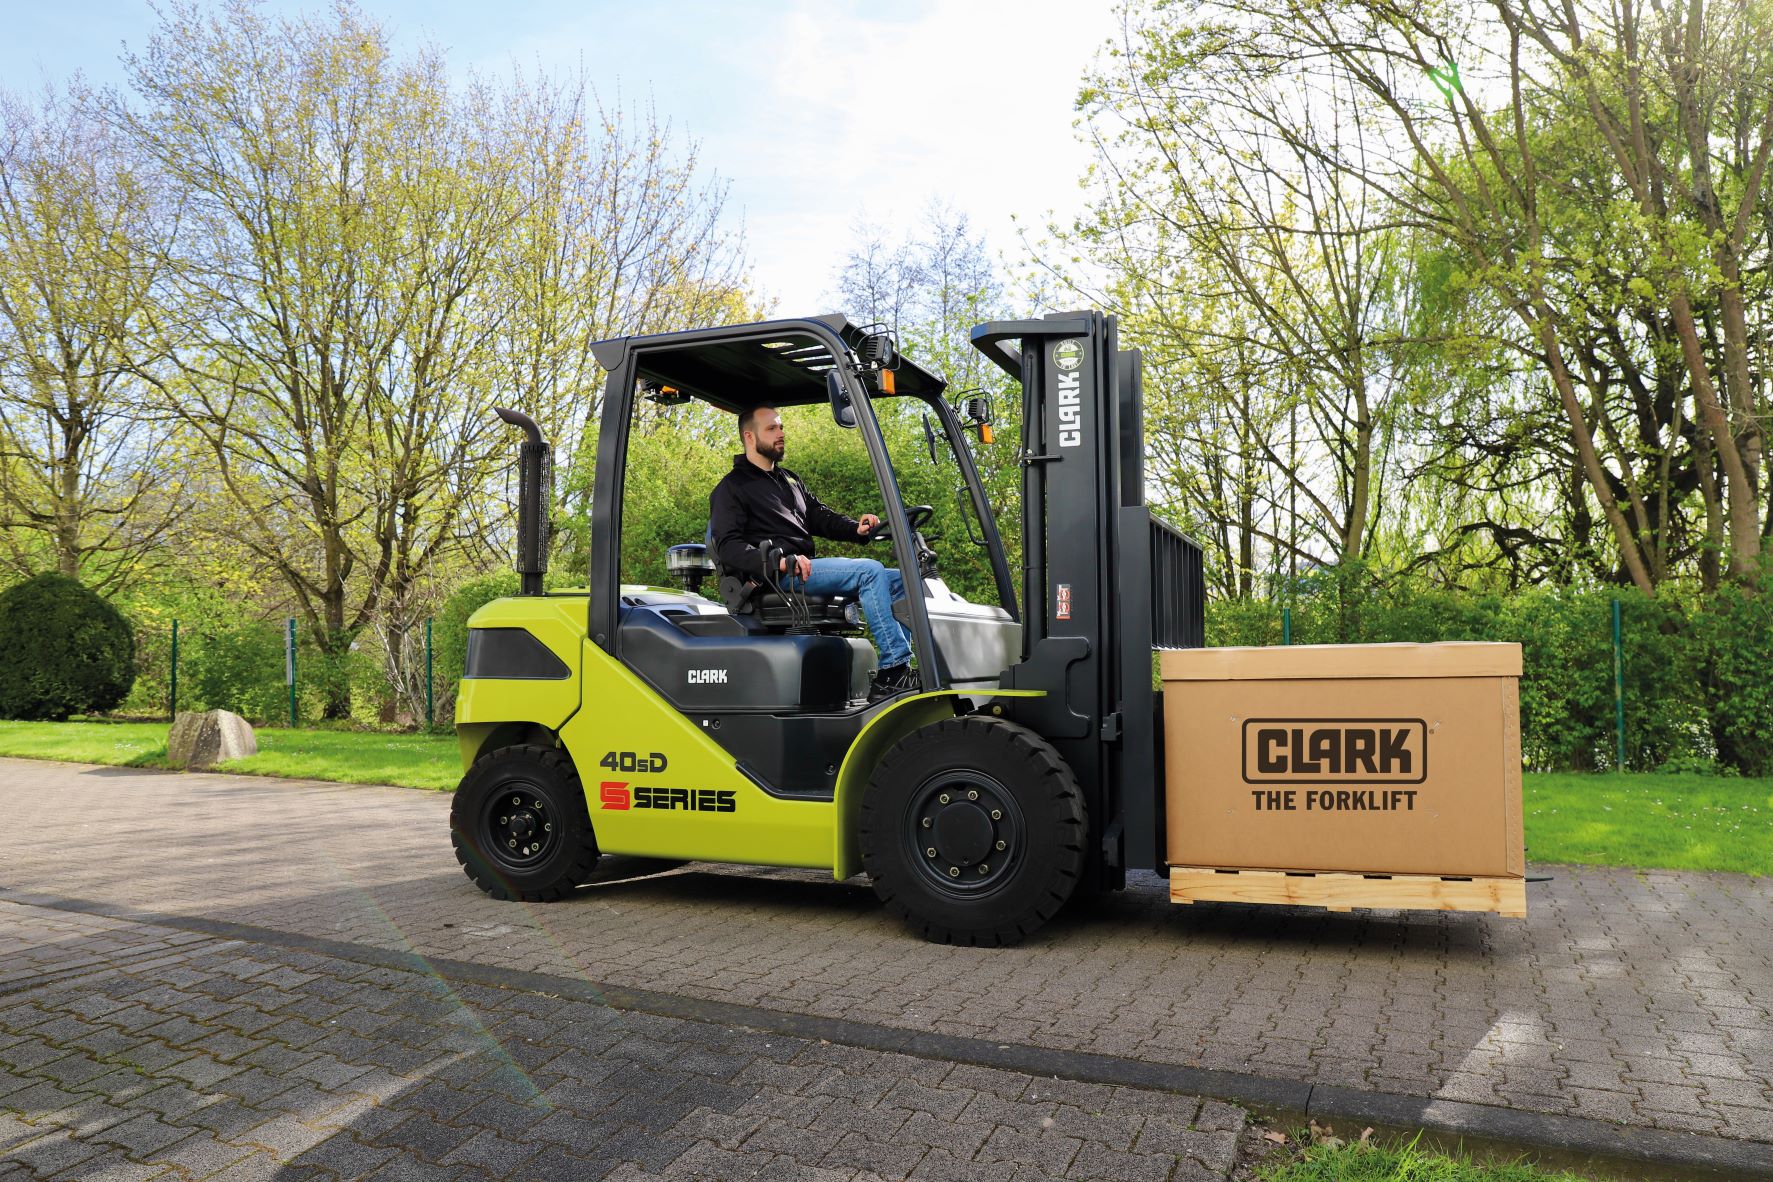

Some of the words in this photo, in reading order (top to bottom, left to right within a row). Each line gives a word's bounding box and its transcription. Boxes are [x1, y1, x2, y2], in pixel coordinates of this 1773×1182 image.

[1058, 372, 1080, 447] CLARK
[688, 669, 728, 684] CLARK
[1257, 728, 1412, 774] CLARK
[633, 787, 737, 812] SERIES
[1251, 790, 1297, 811] THE
[1306, 790, 1418, 811] FORKLIFT
